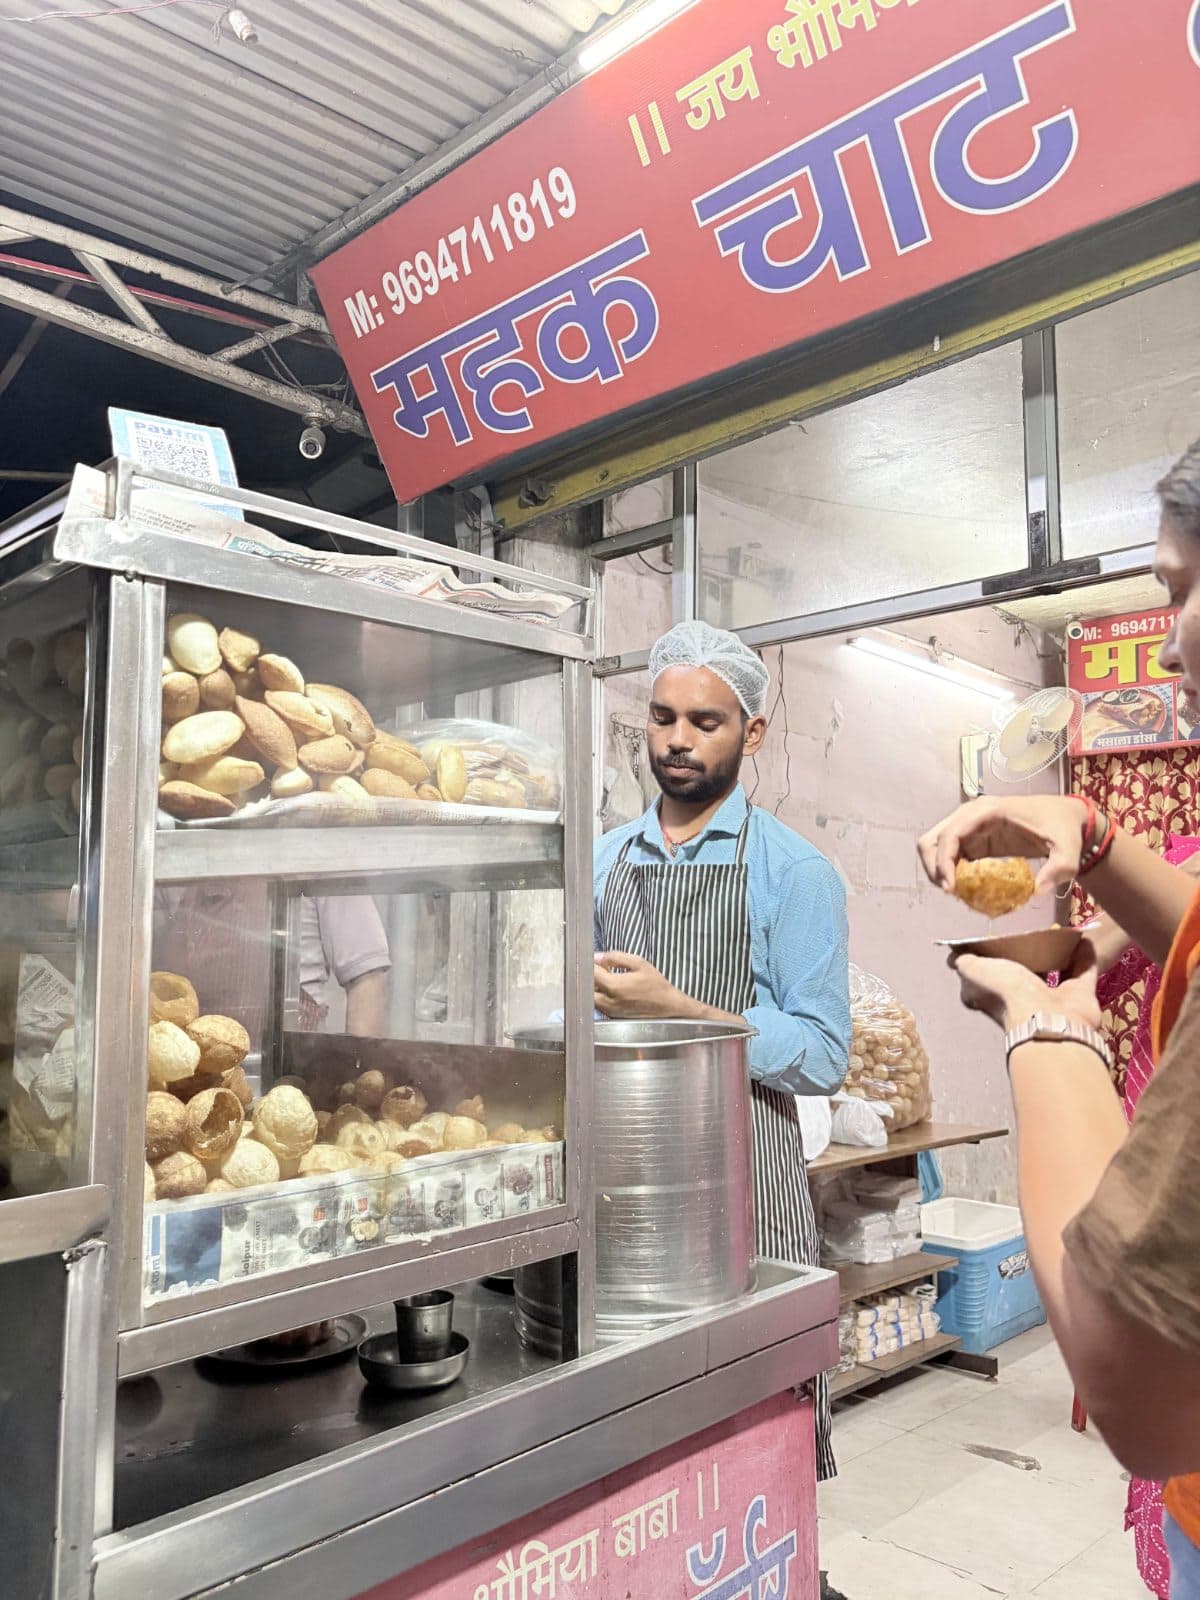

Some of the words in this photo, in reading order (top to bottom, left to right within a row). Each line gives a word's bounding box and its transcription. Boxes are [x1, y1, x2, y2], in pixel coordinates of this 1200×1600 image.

[676, 45, 760, 131] जय
[343, 289, 385, 339] M:
[382, 166, 577, 315] 9694711819
[370, 228, 660, 447] महक
[691, 0, 1079, 294] चाट
[1083, 626, 1102, 642] M:
[1110, 614, 1178, 637] 9694711
[611, 1487, 680, 1558] बाबा
